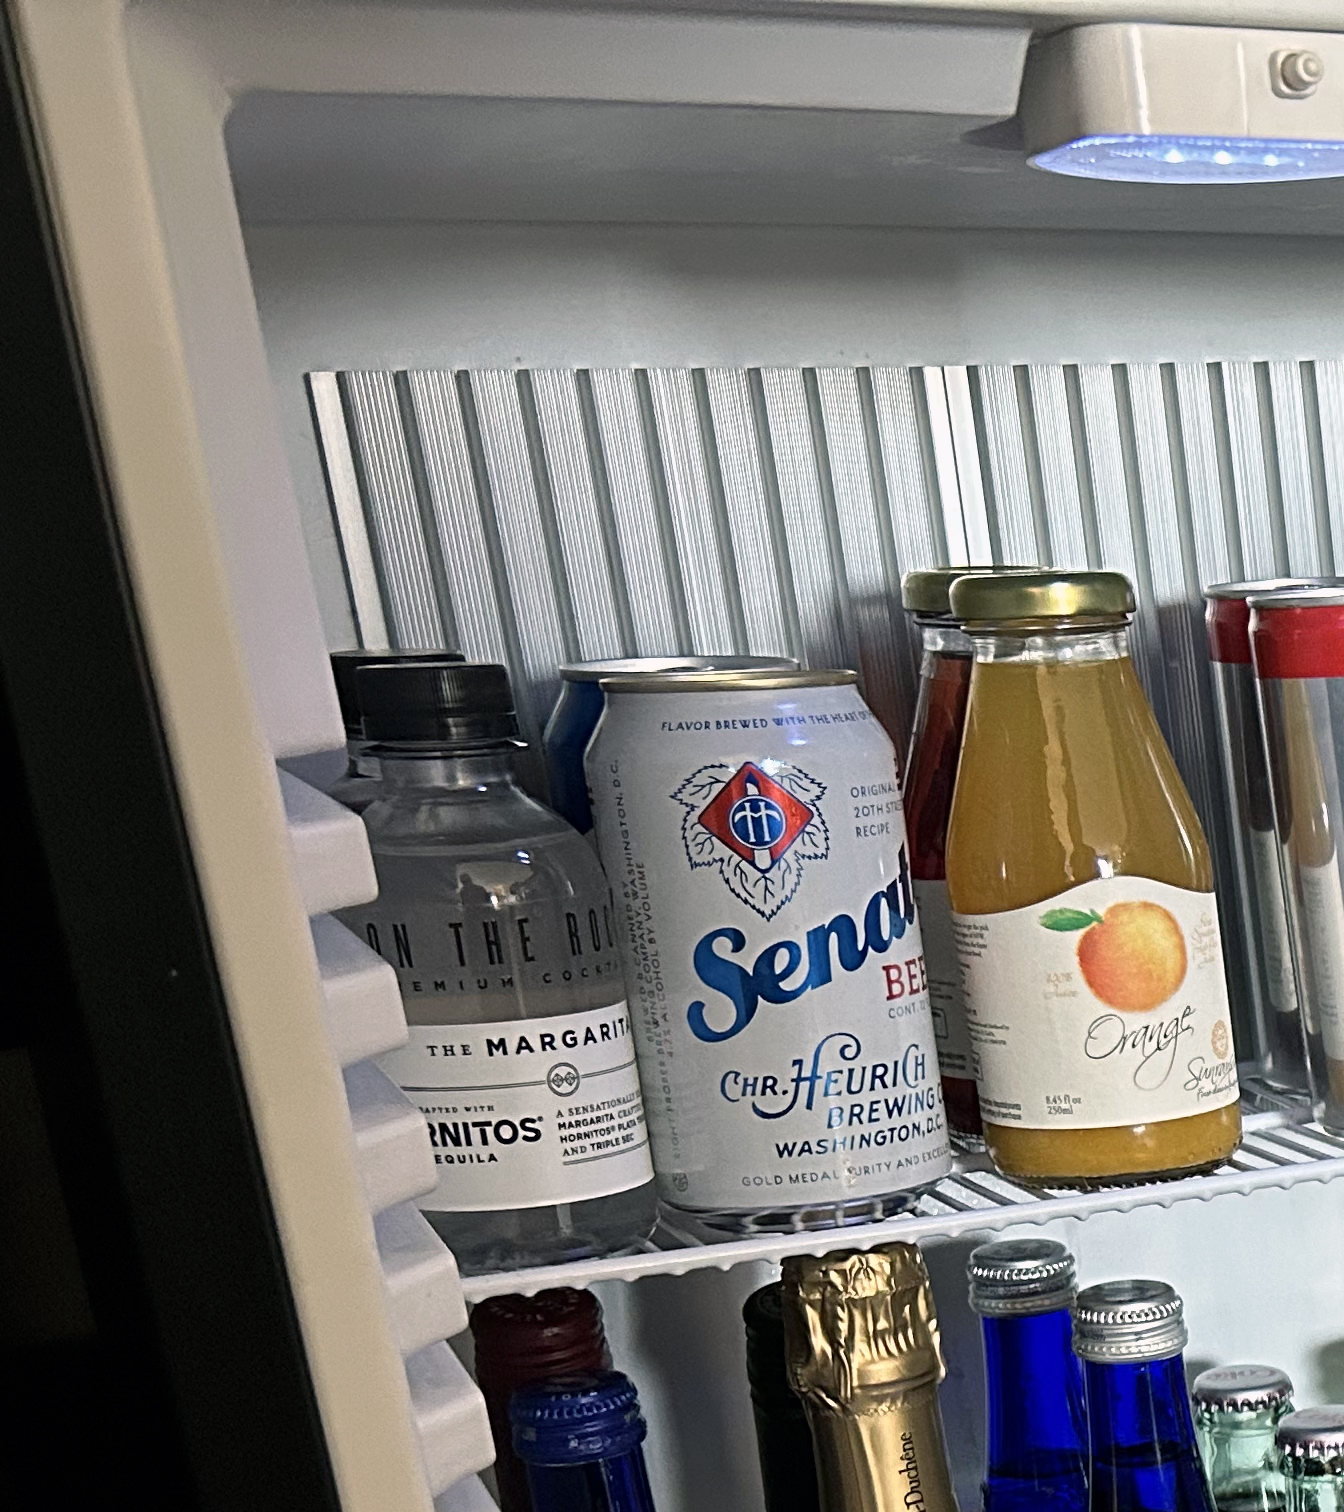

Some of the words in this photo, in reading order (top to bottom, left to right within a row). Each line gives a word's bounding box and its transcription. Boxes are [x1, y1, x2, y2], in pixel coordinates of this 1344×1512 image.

[661, 721, 711, 732] FLAVOR
[715, 718, 768, 730] BREWED
[772, 716, 806, 728] WITH
[808, 714, 831, 725] THE
[854, 803, 884, 818] 20TH
[855, 822, 890, 838] RECIPE
[636, 861, 652, 922] VOLUME
[448, 917, 536, 967] THE
[686, 841, 919, 1043] Senat
[882, 955, 928, 1001] BEE
[427, 1044, 472, 1057] THE
[1084, 1005, 1196, 1091] Orange
[464, 1104, 495, 1113] WITH
[556, 1109, 564, 1118] A
[568, 1092, 635, 1117] SENSATIONALLY
[827, 1087, 934, 1129] BREWING
[558, 1112, 616, 1131] MARGARITA
[618, 1119, 637, 1132] PLATA
[563, 1145, 587, 1157] AND
[590, 1139, 620, 1152] TRIPLE
[622, 1132, 634, 1145] SEC
[775, 1121, 926, 1159] WASHINGTON,
[435, 1153, 498, 1164] EQUILA
[741, 1175, 783, 1187] GOLD
[788, 1169, 839, 1185] MEDAL
[896, 1154, 919, 1169] AND
